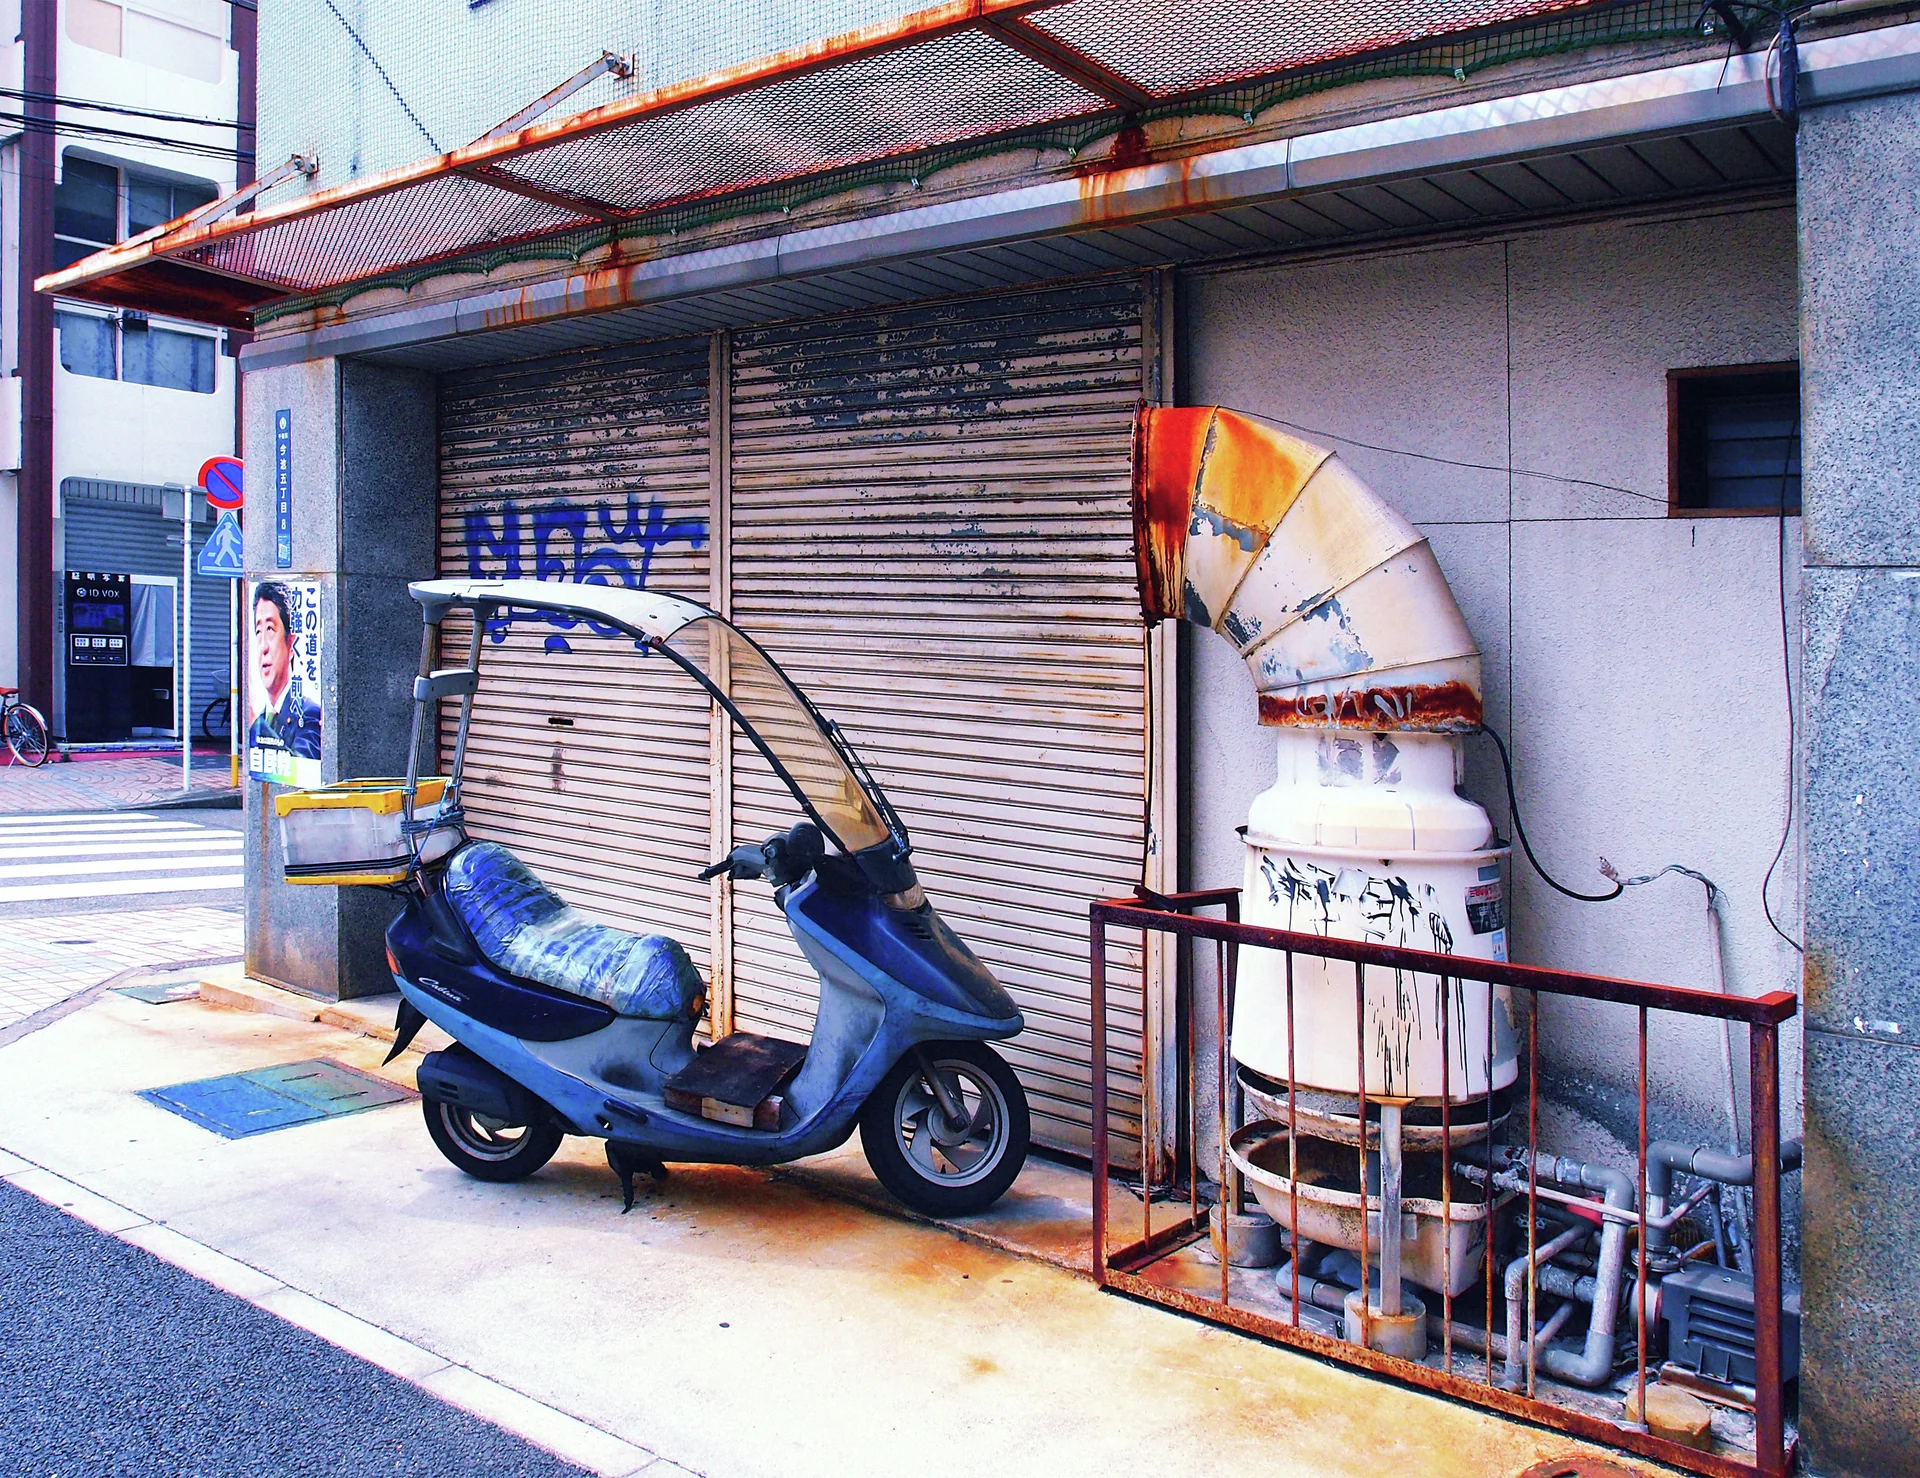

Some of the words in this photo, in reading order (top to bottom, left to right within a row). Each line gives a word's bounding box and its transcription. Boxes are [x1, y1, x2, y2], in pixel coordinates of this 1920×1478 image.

[89, 588, 100, 597] ID
[101, 589, 120, 598] VOX
[305, 587, 318, 690] この道を。
[249, 747, 291, 776] 自民党
[418, 977, 462, 1001] Cabina
